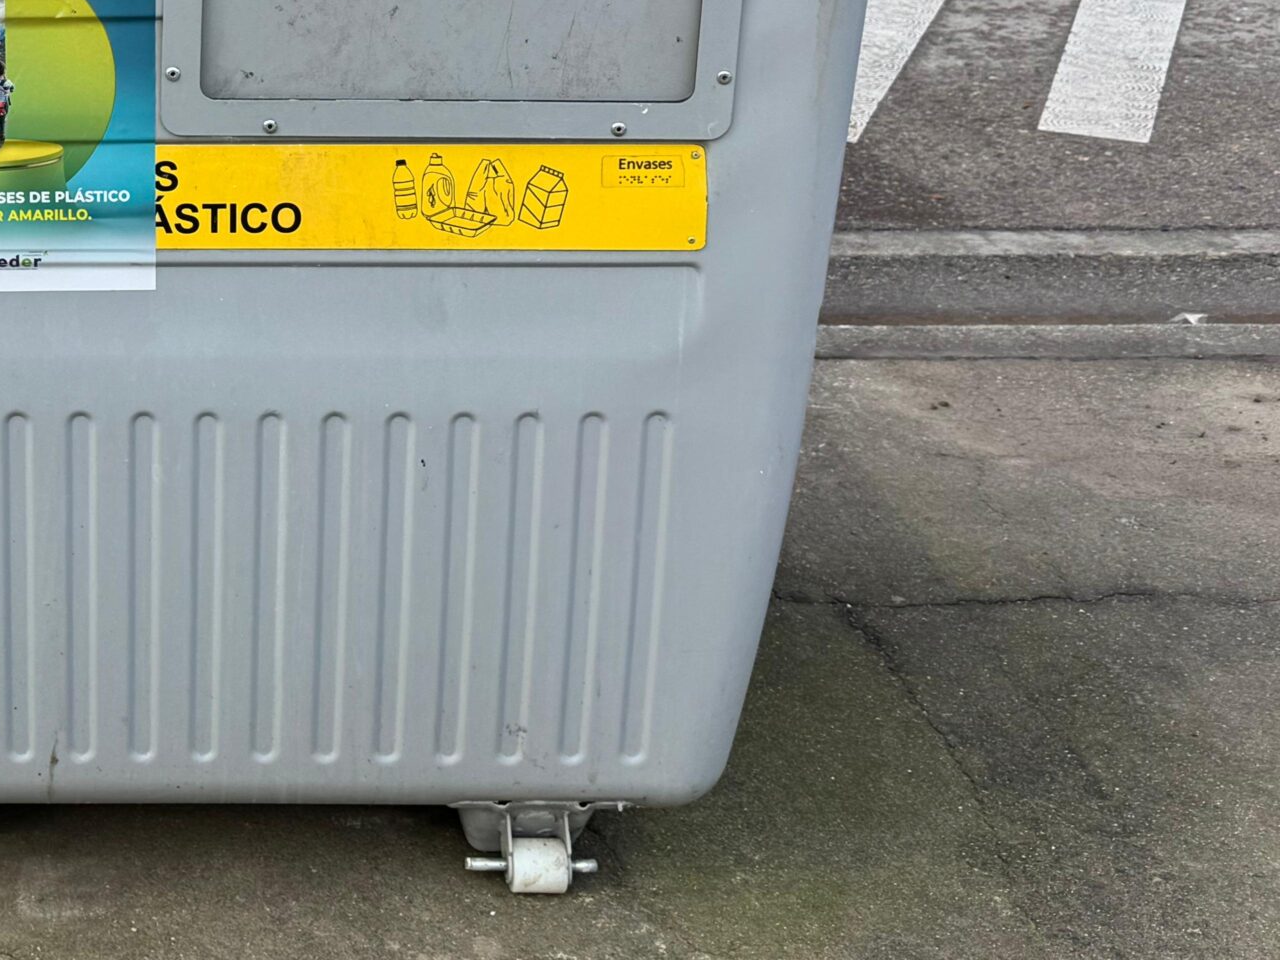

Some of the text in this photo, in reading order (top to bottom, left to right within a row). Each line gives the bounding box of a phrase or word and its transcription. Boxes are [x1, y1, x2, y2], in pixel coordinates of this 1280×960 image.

[618, 158, 673, 170] Envases
[29, 190, 50, 204] DE
[54, 187, 130, 204] PLÁSTICO
[7, 208, 93, 223] AMARILLO.
